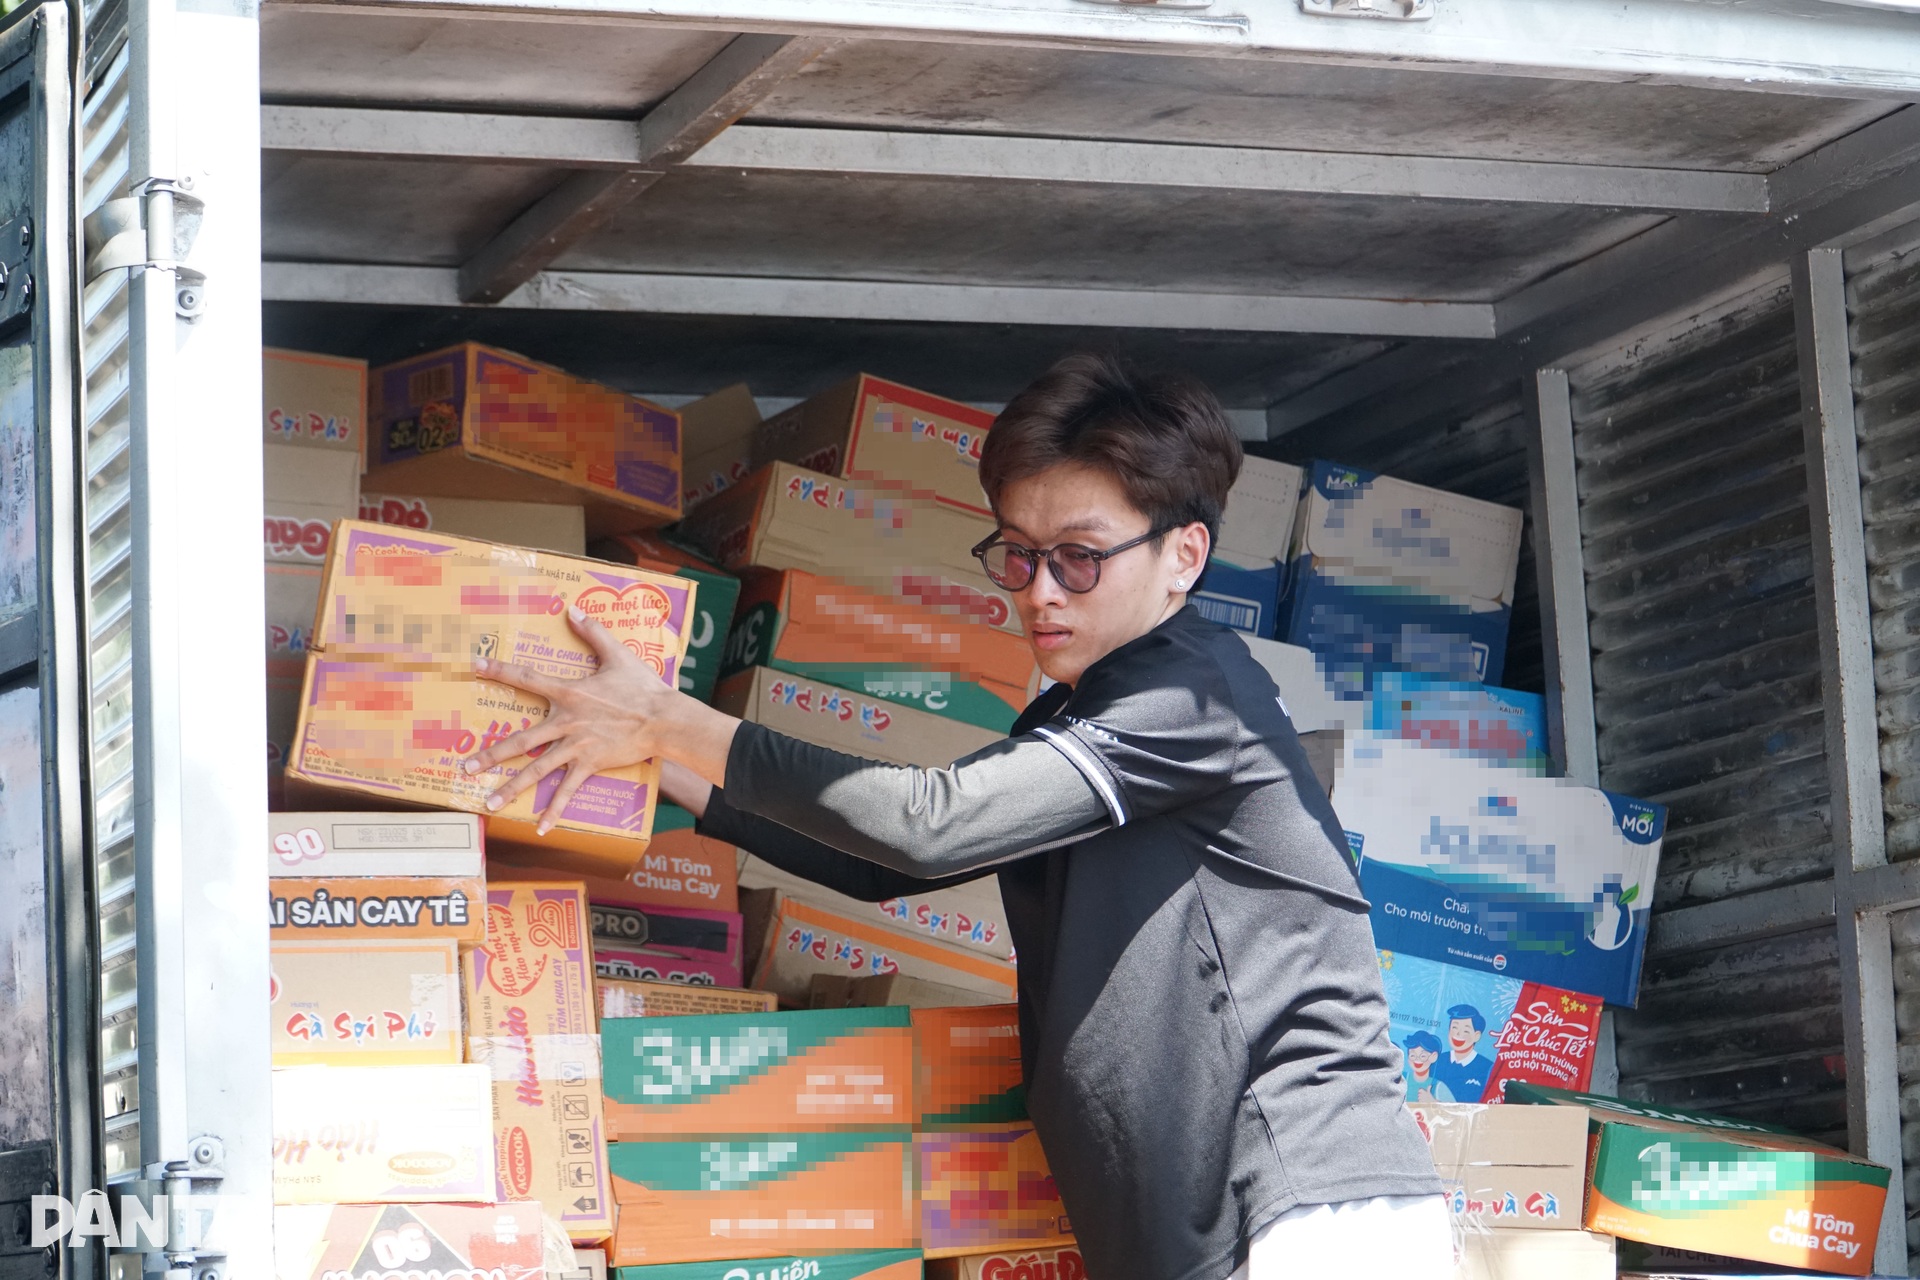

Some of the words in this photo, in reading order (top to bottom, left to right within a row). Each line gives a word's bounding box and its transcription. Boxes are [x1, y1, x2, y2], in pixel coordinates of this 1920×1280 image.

[268, 408, 302, 438] Sợi
[307, 411, 351, 441] Phở
[611, 596, 639, 616] mọi
[617, 614, 641, 631] mọi
[532, 644, 554, 657] TÔM
[556, 648, 583, 662] CHUA
[771, 682, 812, 713] Phở
[819, 692, 853, 722] Sợi
[861, 706, 892, 733] Gà
[585, 785, 611, 797] TRONG
[612, 790, 635, 801] NƯỚC
[607, 798, 626, 809] ONLY
[1622, 814, 1654, 837] MỚI
[274, 828, 325, 865] 90
[644, 855, 667, 872] Mì
[670, 858, 712, 877] Tôm
[632, 871, 682, 891] Chua
[685, 877, 721, 899] Cay
[291, 891, 354, 925] SẢN
[360, 899, 423, 925] CAY
[428, 894, 467, 924] TÊ
[1384, 902, 1407, 918] Cho
[1410, 908, 1431, 924] môi
[1434, 914, 1471, 935] trường
[526, 899, 566, 949] 25
[916, 904, 948, 933] Sợi
[956, 912, 997, 944] Phở
[788, 928, 828, 961] Phở
[834, 939, 865, 970] Sợi
[552, 957, 563, 977] CAY
[554, 979, 565, 1006] CHUA
[286, 1012, 324, 1041] Gà
[333, 1012, 376, 1046] Sợi
[383, 1011, 437, 1041] Phở
[557, 1008, 568, 1029] TÔM
[1512, 1001, 1589, 1032] Săn
[1490, 1021, 1522, 1048] Lời
[1498, 1050, 1530, 1061] TRONG
[1549, 1056, 1579, 1077] THÚNG,
[1508, 1058, 1521, 1069] CƠ
[1523, 1060, 1539, 1072] HỘI
[1541, 1063, 1569, 1082] TRÚNG
[1491, 1191, 1518, 1216] và
[1524, 1191, 1559, 1218] Gà
[1785, 1209, 1809, 1227] Mì
[1814, 1212, 1856, 1236] Tôm
[1768, 1226, 1818, 1249] Chua
[1822, 1235, 1863, 1260] Cay
